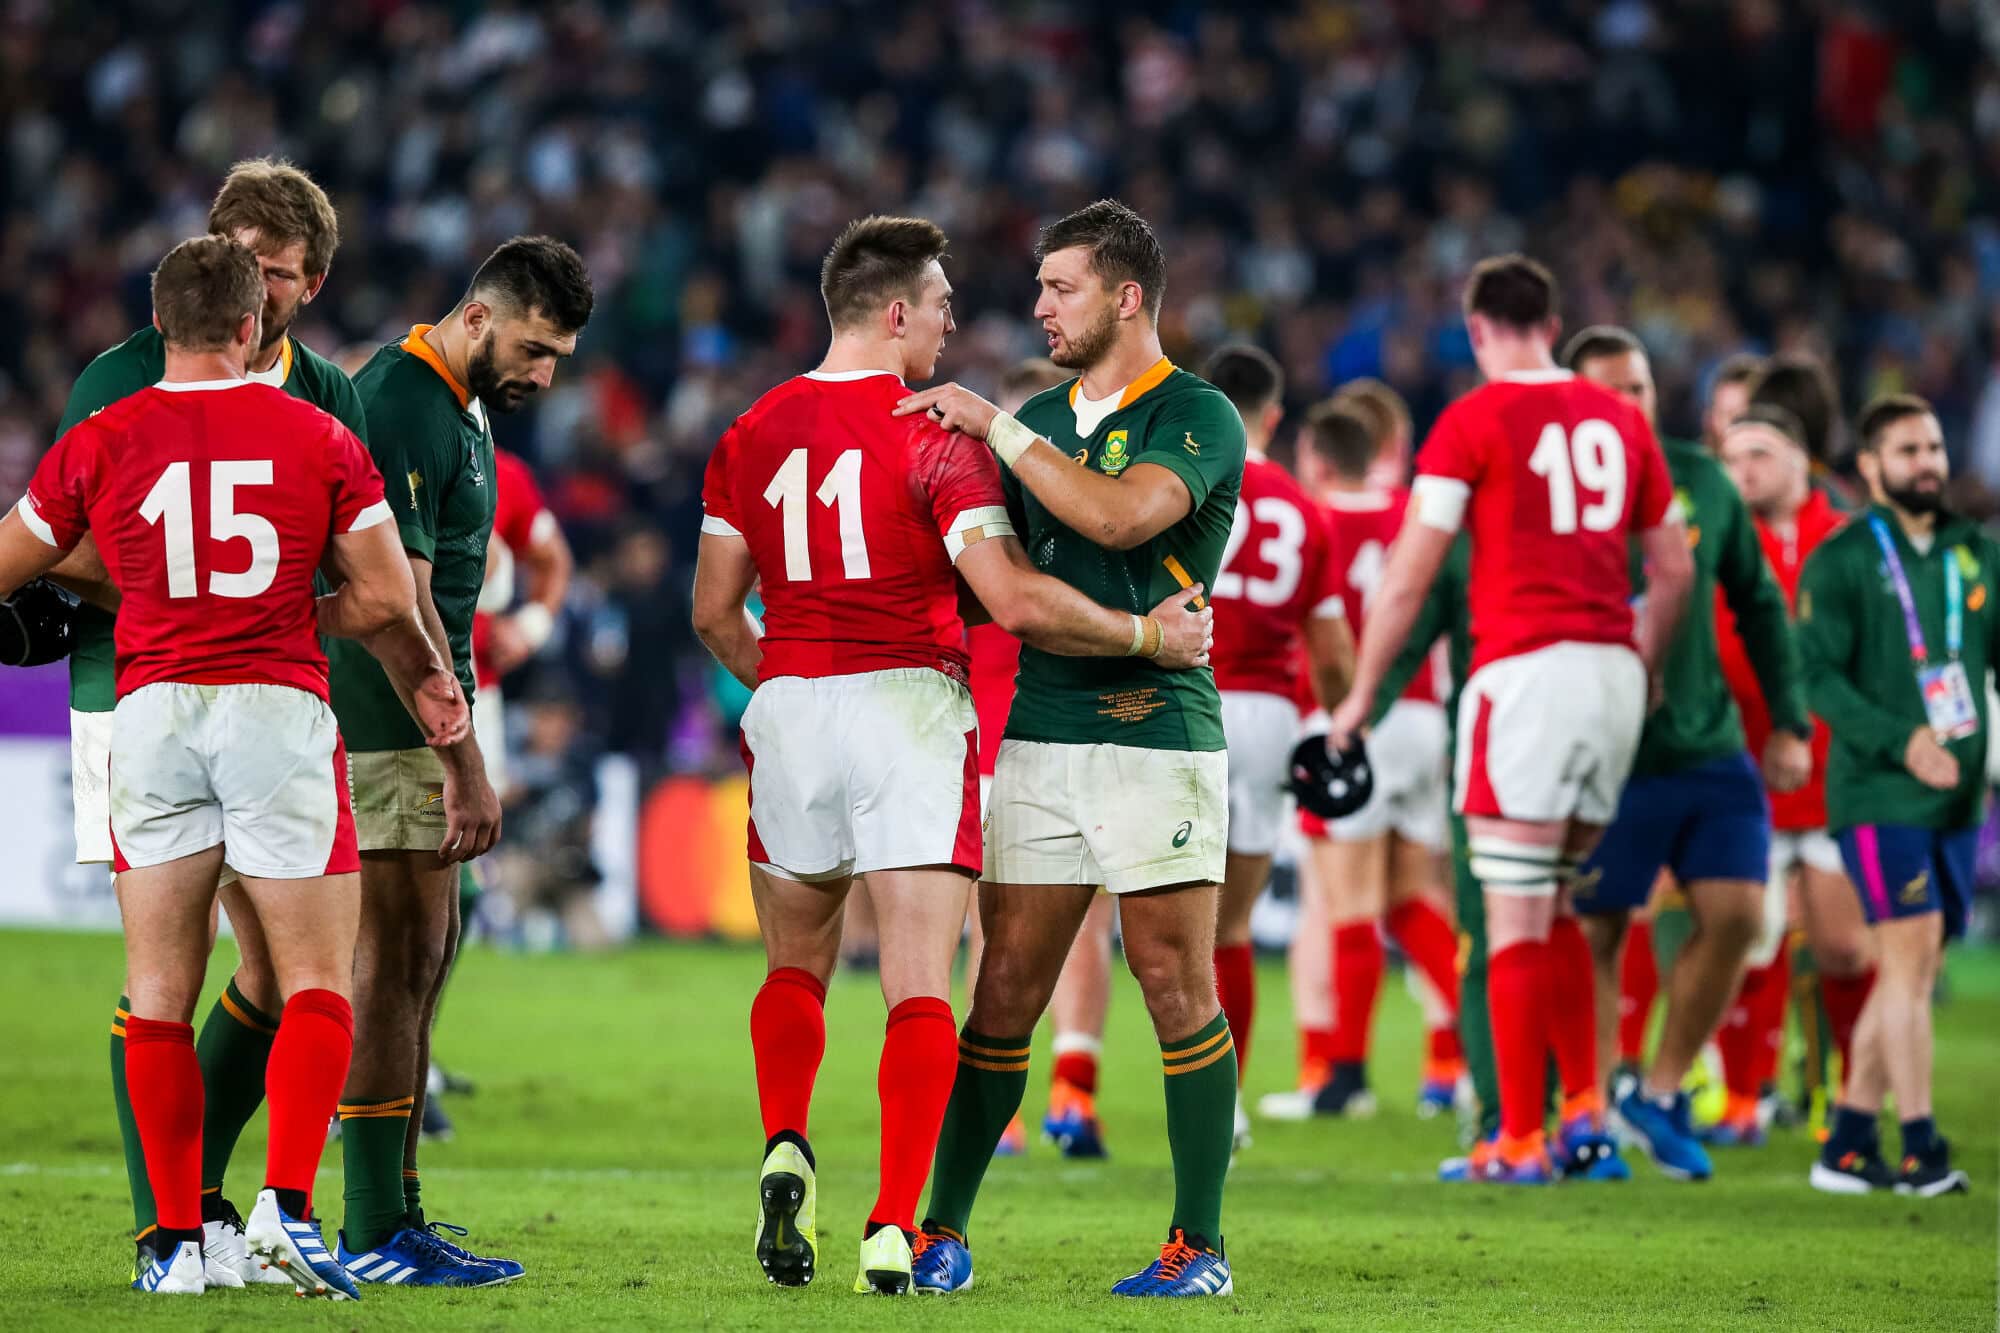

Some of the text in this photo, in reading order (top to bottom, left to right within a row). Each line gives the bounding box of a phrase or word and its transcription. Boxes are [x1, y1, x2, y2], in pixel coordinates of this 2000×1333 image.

[138, 459, 280, 599] 15
[763, 448, 871, 582] 11
[1529, 419, 1627, 534] 19
[1210, 497, 1305, 604] 23
